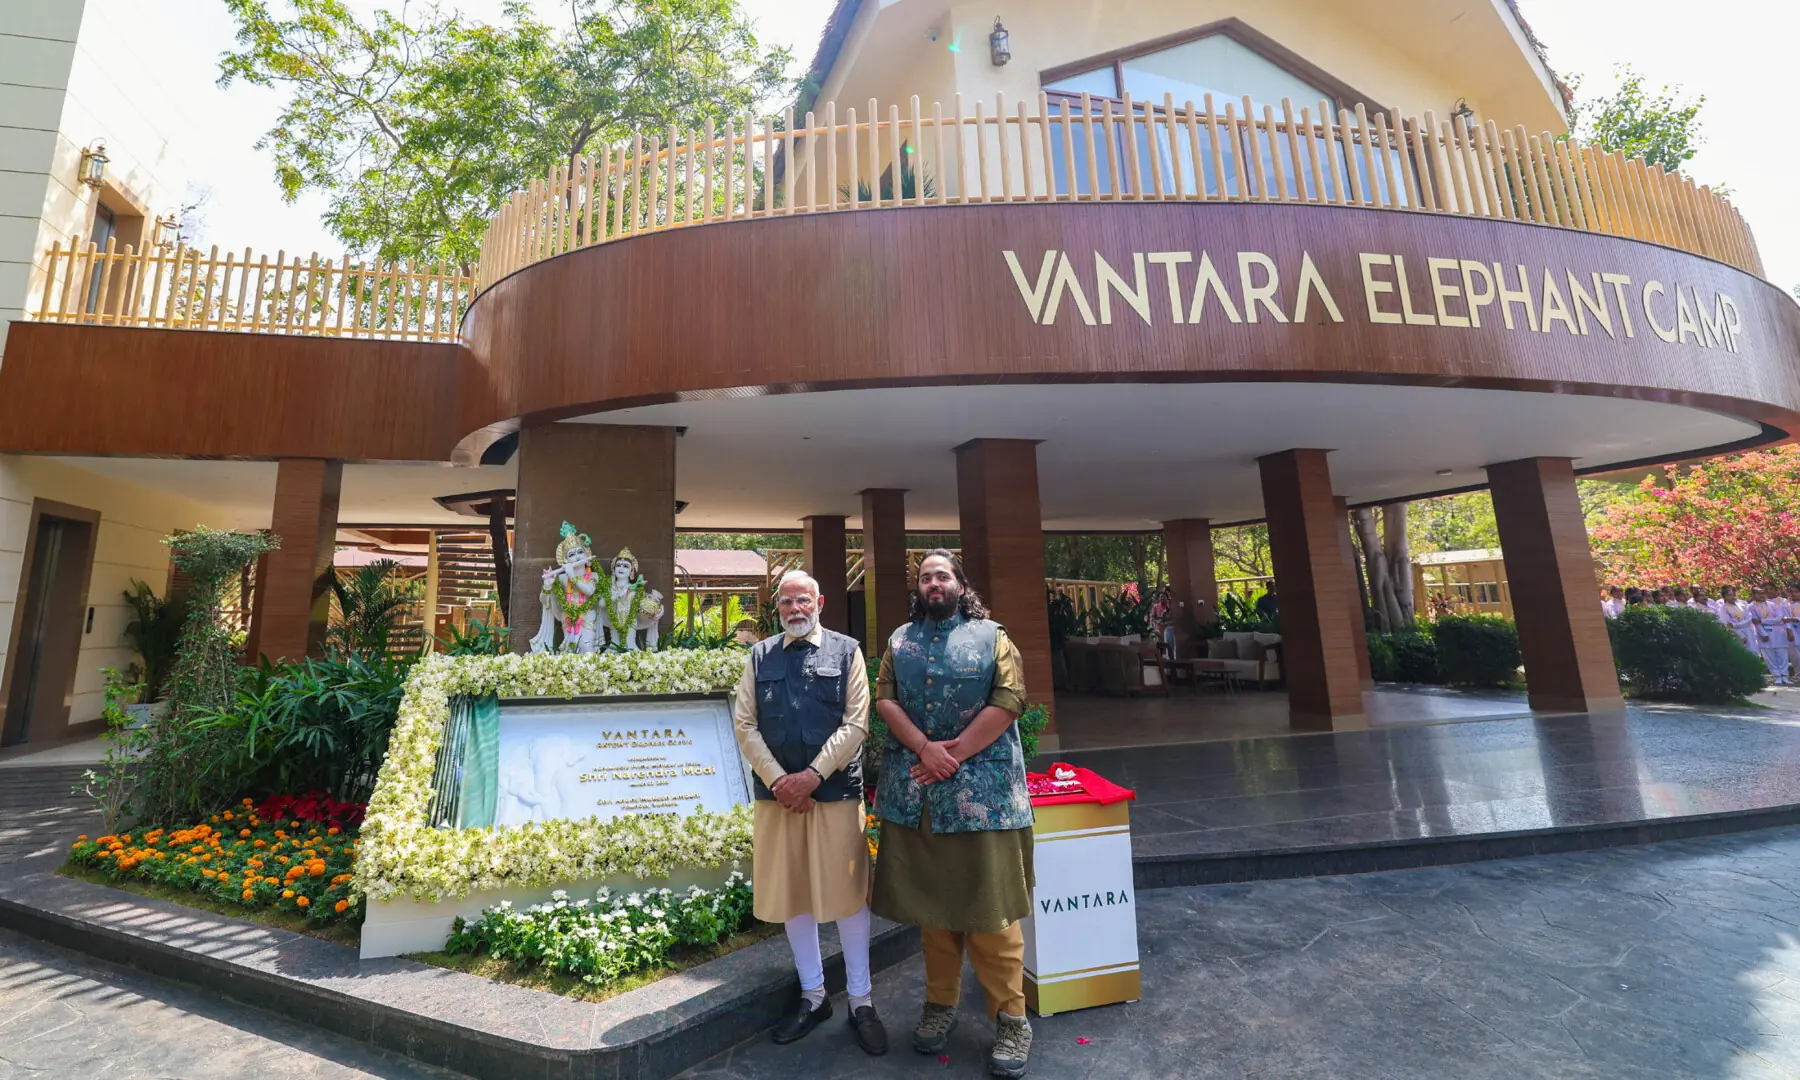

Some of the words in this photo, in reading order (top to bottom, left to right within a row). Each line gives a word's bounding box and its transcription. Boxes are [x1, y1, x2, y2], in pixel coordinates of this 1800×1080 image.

[1001, 250, 1345, 327] VANTARA
[1358, 252, 1634, 339] ELEPHANT
[1641, 280, 1742, 354] CAMP
[601, 728, 687, 740] VANTARA
[579, 772, 608, 783] Shri
[611, 768, 678, 781] Narendra
[681, 765, 716, 777] Modi
[1040, 889, 1129, 914] VANTARA
